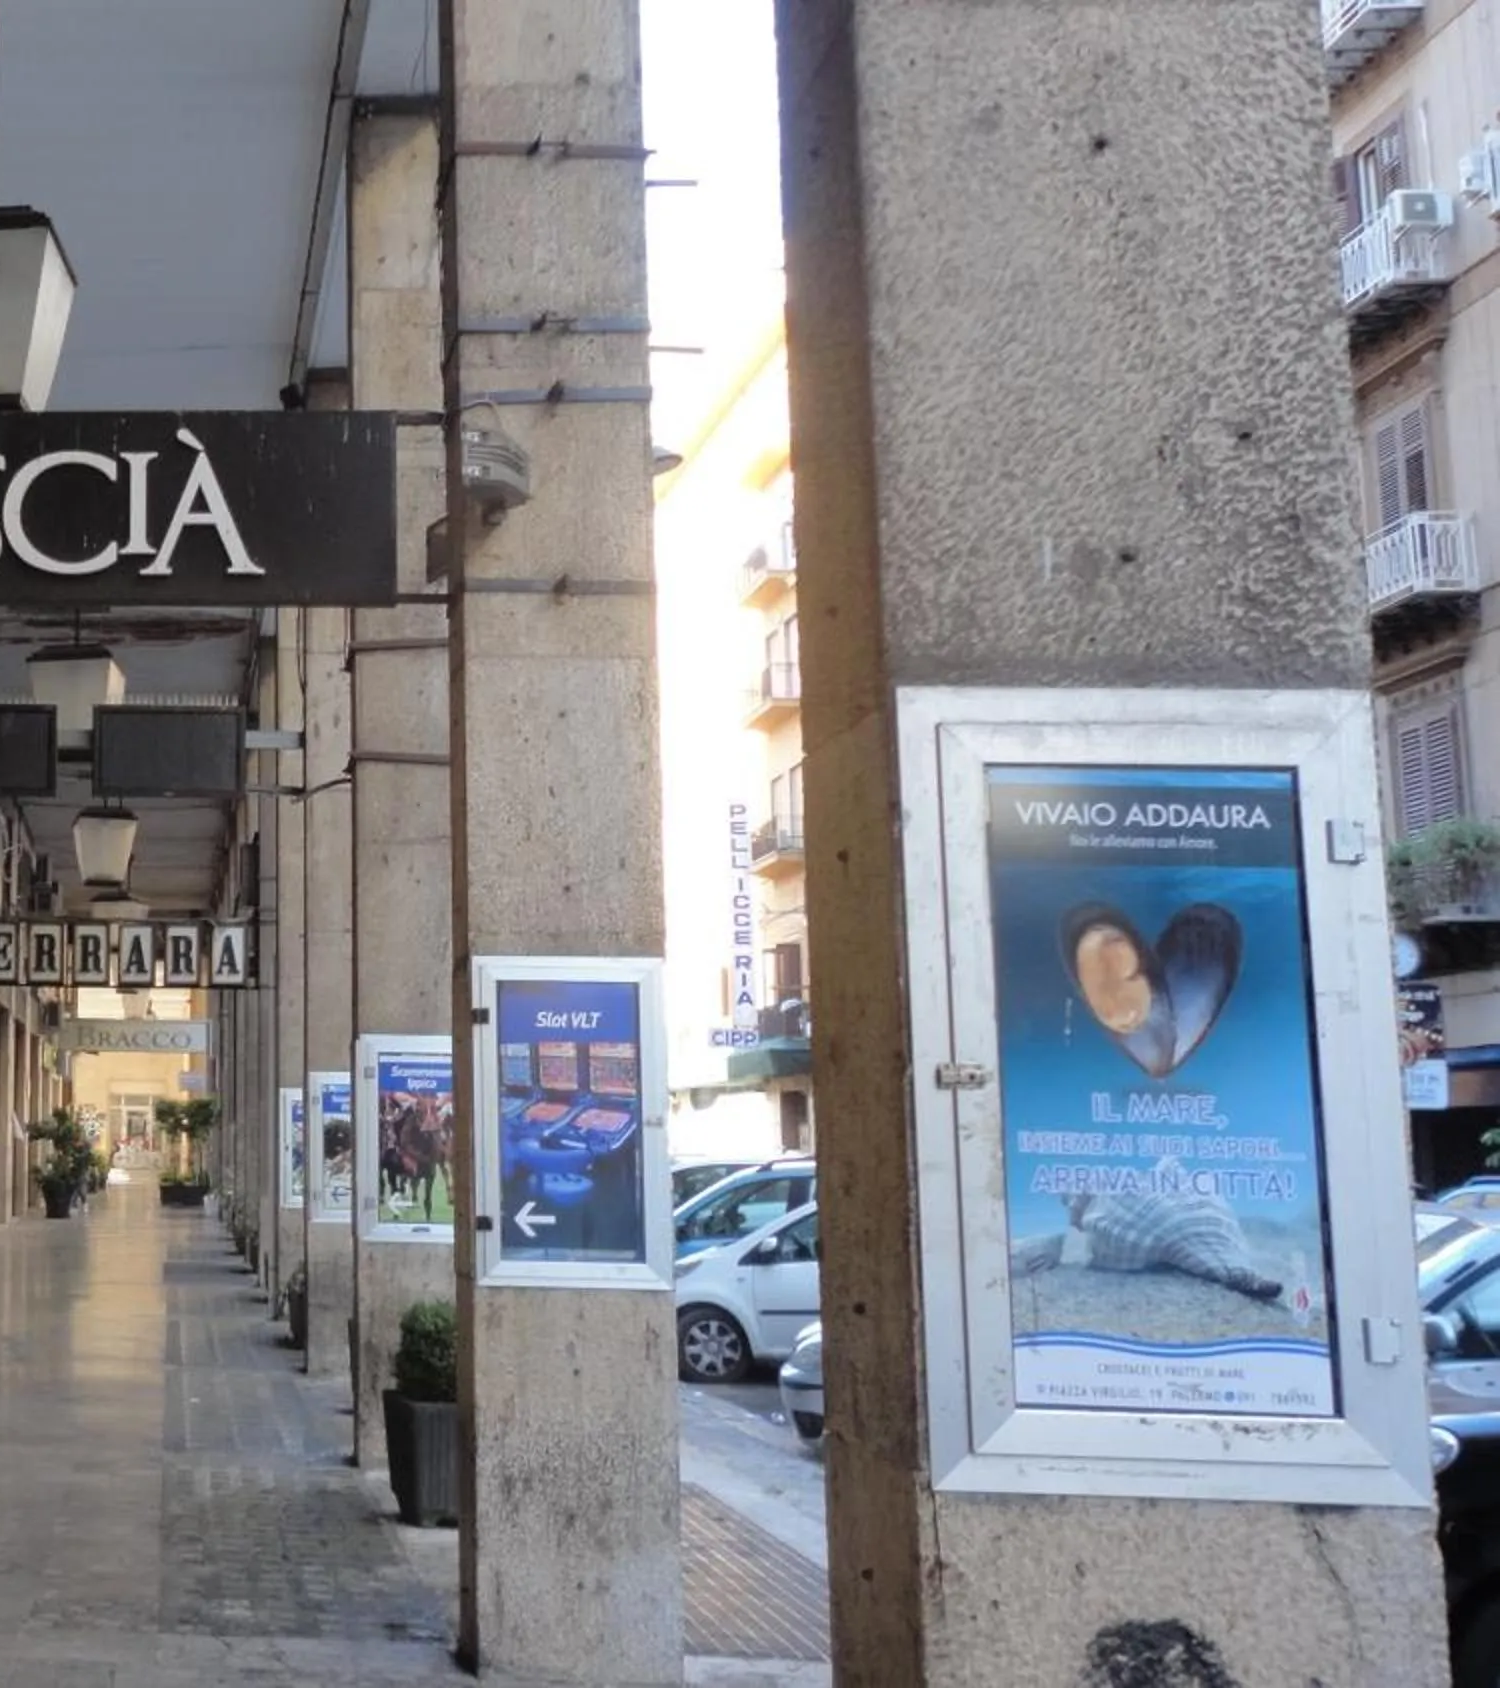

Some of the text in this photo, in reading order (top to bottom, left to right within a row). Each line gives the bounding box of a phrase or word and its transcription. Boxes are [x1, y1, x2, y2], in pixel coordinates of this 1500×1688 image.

[1015, 802, 1271, 829] VIVAIO ADDAURA
[729, 804, 754, 1005] PELLICCERIA
[535, 1011, 602, 1029] Slot VLT
[1091, 1092, 1229, 1130] IL MARE,
[1031, 1164, 1140, 1195] ARRIVA
[1148, 1168, 1181, 1195] IN
